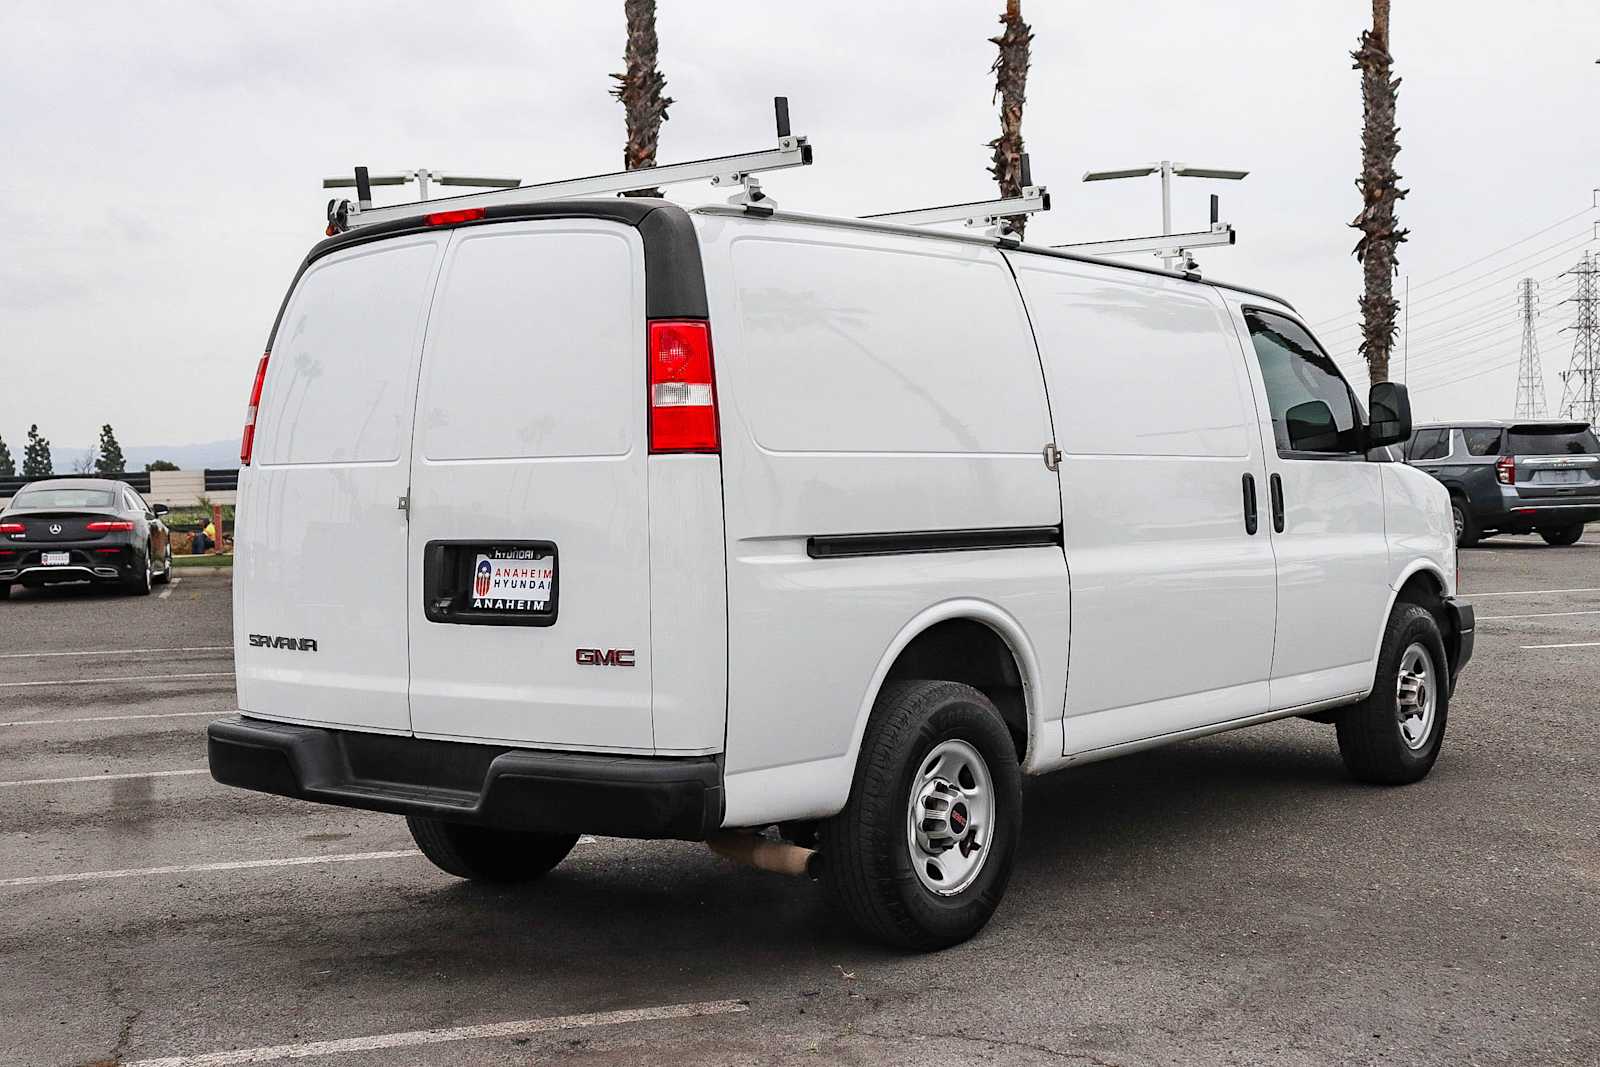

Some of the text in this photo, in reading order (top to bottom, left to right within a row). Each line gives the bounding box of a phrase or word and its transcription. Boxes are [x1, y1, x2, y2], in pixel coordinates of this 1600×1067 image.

[495, 569, 552, 579] ANAHEIM
[494, 579, 551, 589] HYUNDAI
[473, 599, 545, 611] ANAHEIM
[249, 634, 317, 652] SAVANA
[576, 649, 635, 667] GMC
